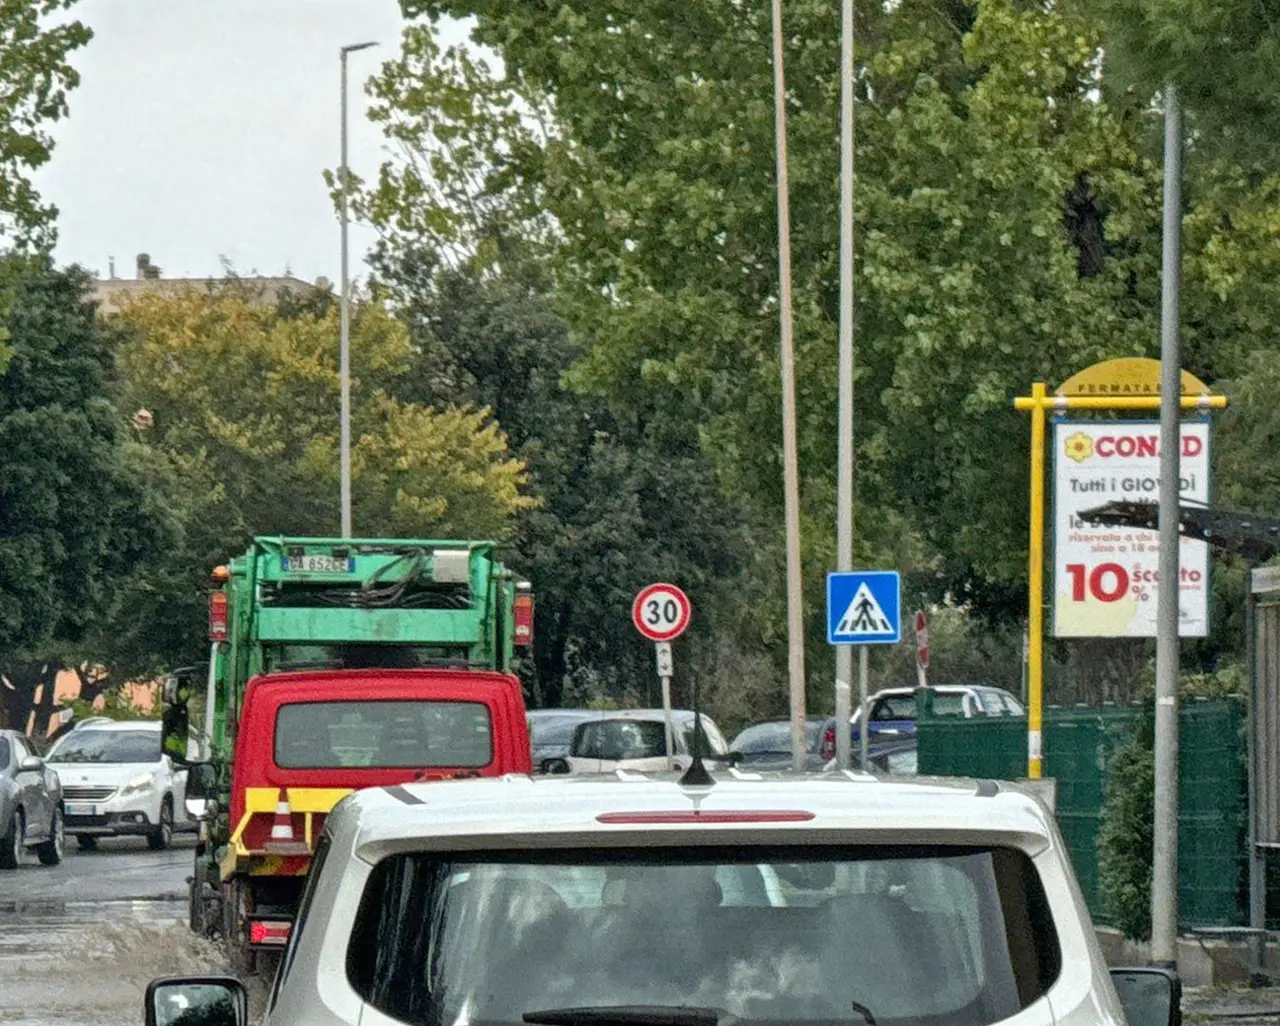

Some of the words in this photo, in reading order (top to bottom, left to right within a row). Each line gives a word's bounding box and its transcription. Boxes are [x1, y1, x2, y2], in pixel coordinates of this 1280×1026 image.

[1078, 384, 1151, 393] FERMATA
[1095, 436, 1203, 457] COND
[1070, 480, 1106, 492] Tutti
[1065, 563, 1130, 603] 10
[1132, 568, 1202, 583] scoto
[646, 599, 678, 625] 30
